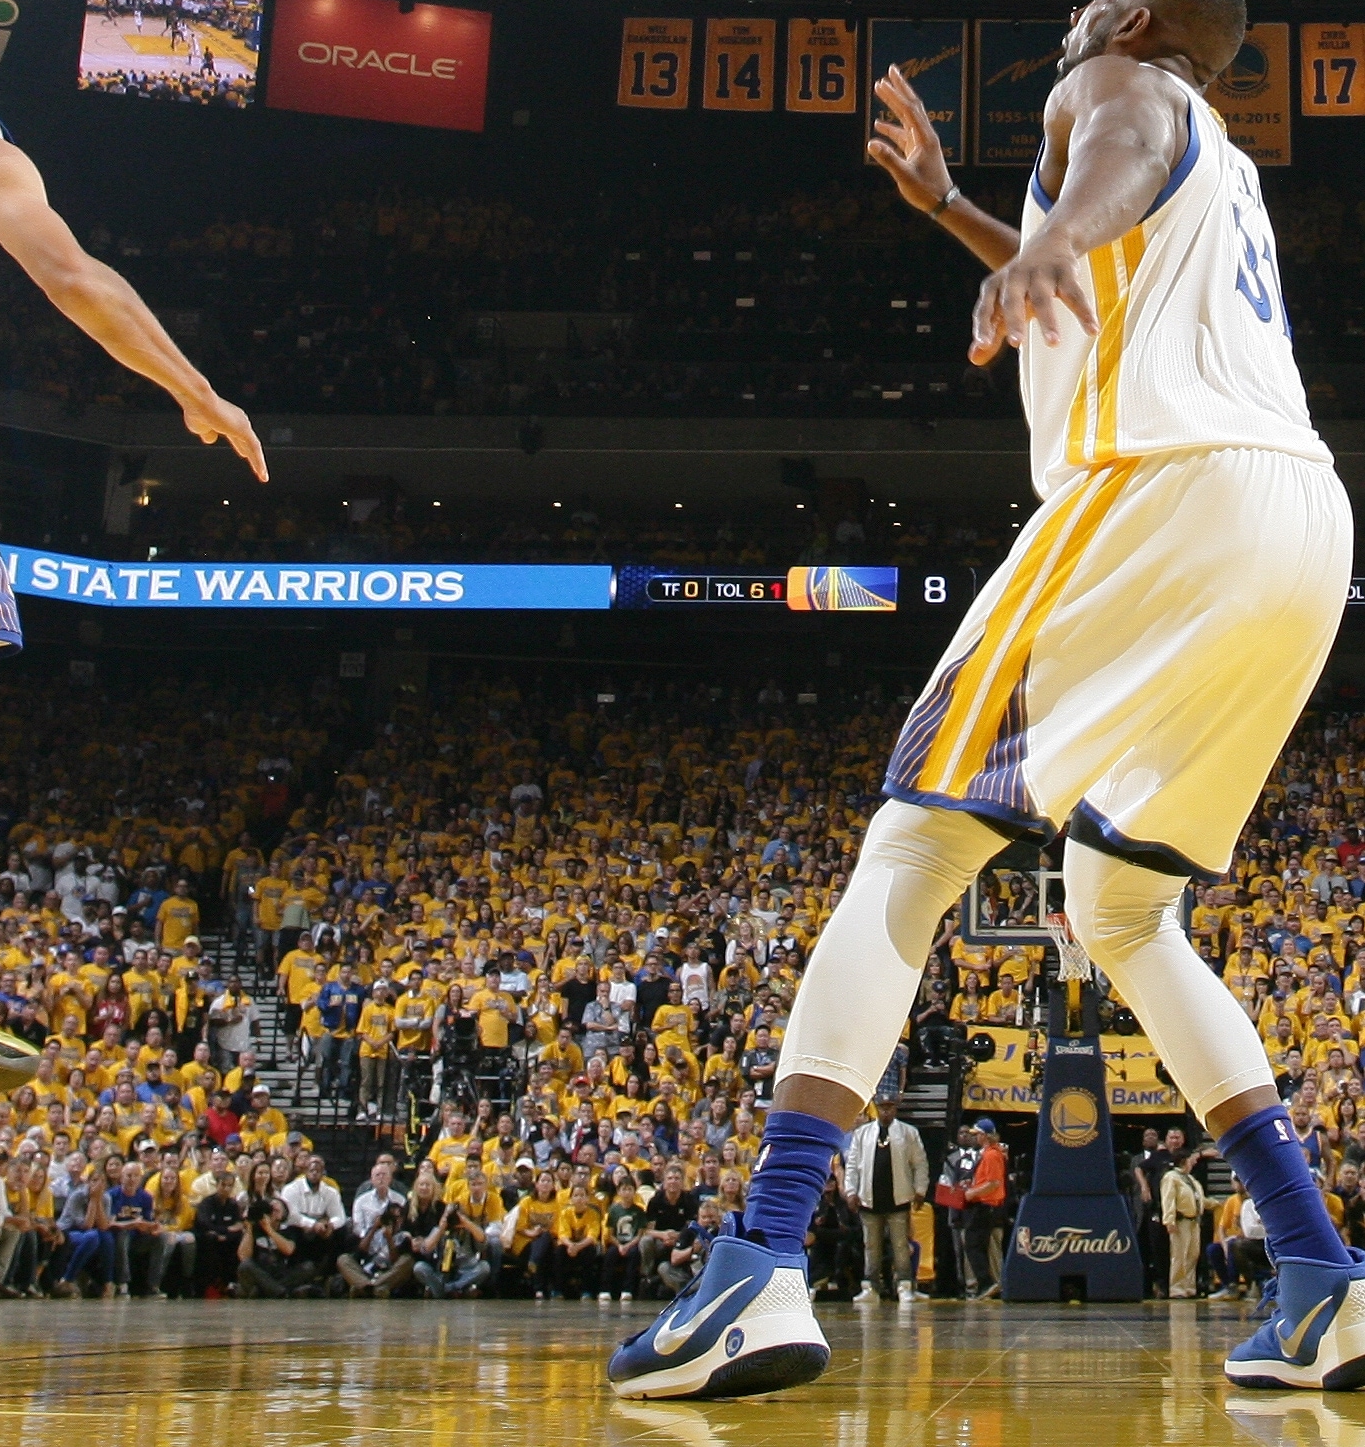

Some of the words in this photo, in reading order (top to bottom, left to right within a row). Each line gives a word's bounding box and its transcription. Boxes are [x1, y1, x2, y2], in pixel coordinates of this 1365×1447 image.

[298, 41, 457, 80] ORACLE
[630, 52, 679, 98] 13
[716, 53, 762, 100] 14
[798, 53, 846, 102] 16
[1312, 57, 1358, 105] 17
[30, 556, 181, 601] STATE
[194, 569, 466, 602] WARRIORS
[661, 582, 681, 597] TF
[683, 580, 700, 599] 0
[715, 582, 745, 599] TOL
[748, 581, 765, 600] 6
[769, 582, 784, 600] 1
[923, 575, 947, 603] 8
[967, 1084, 1007, 1103] CITY
[1112, 1088, 1165, 1106] BANK
[1025, 1226, 1132, 1263] Finals
